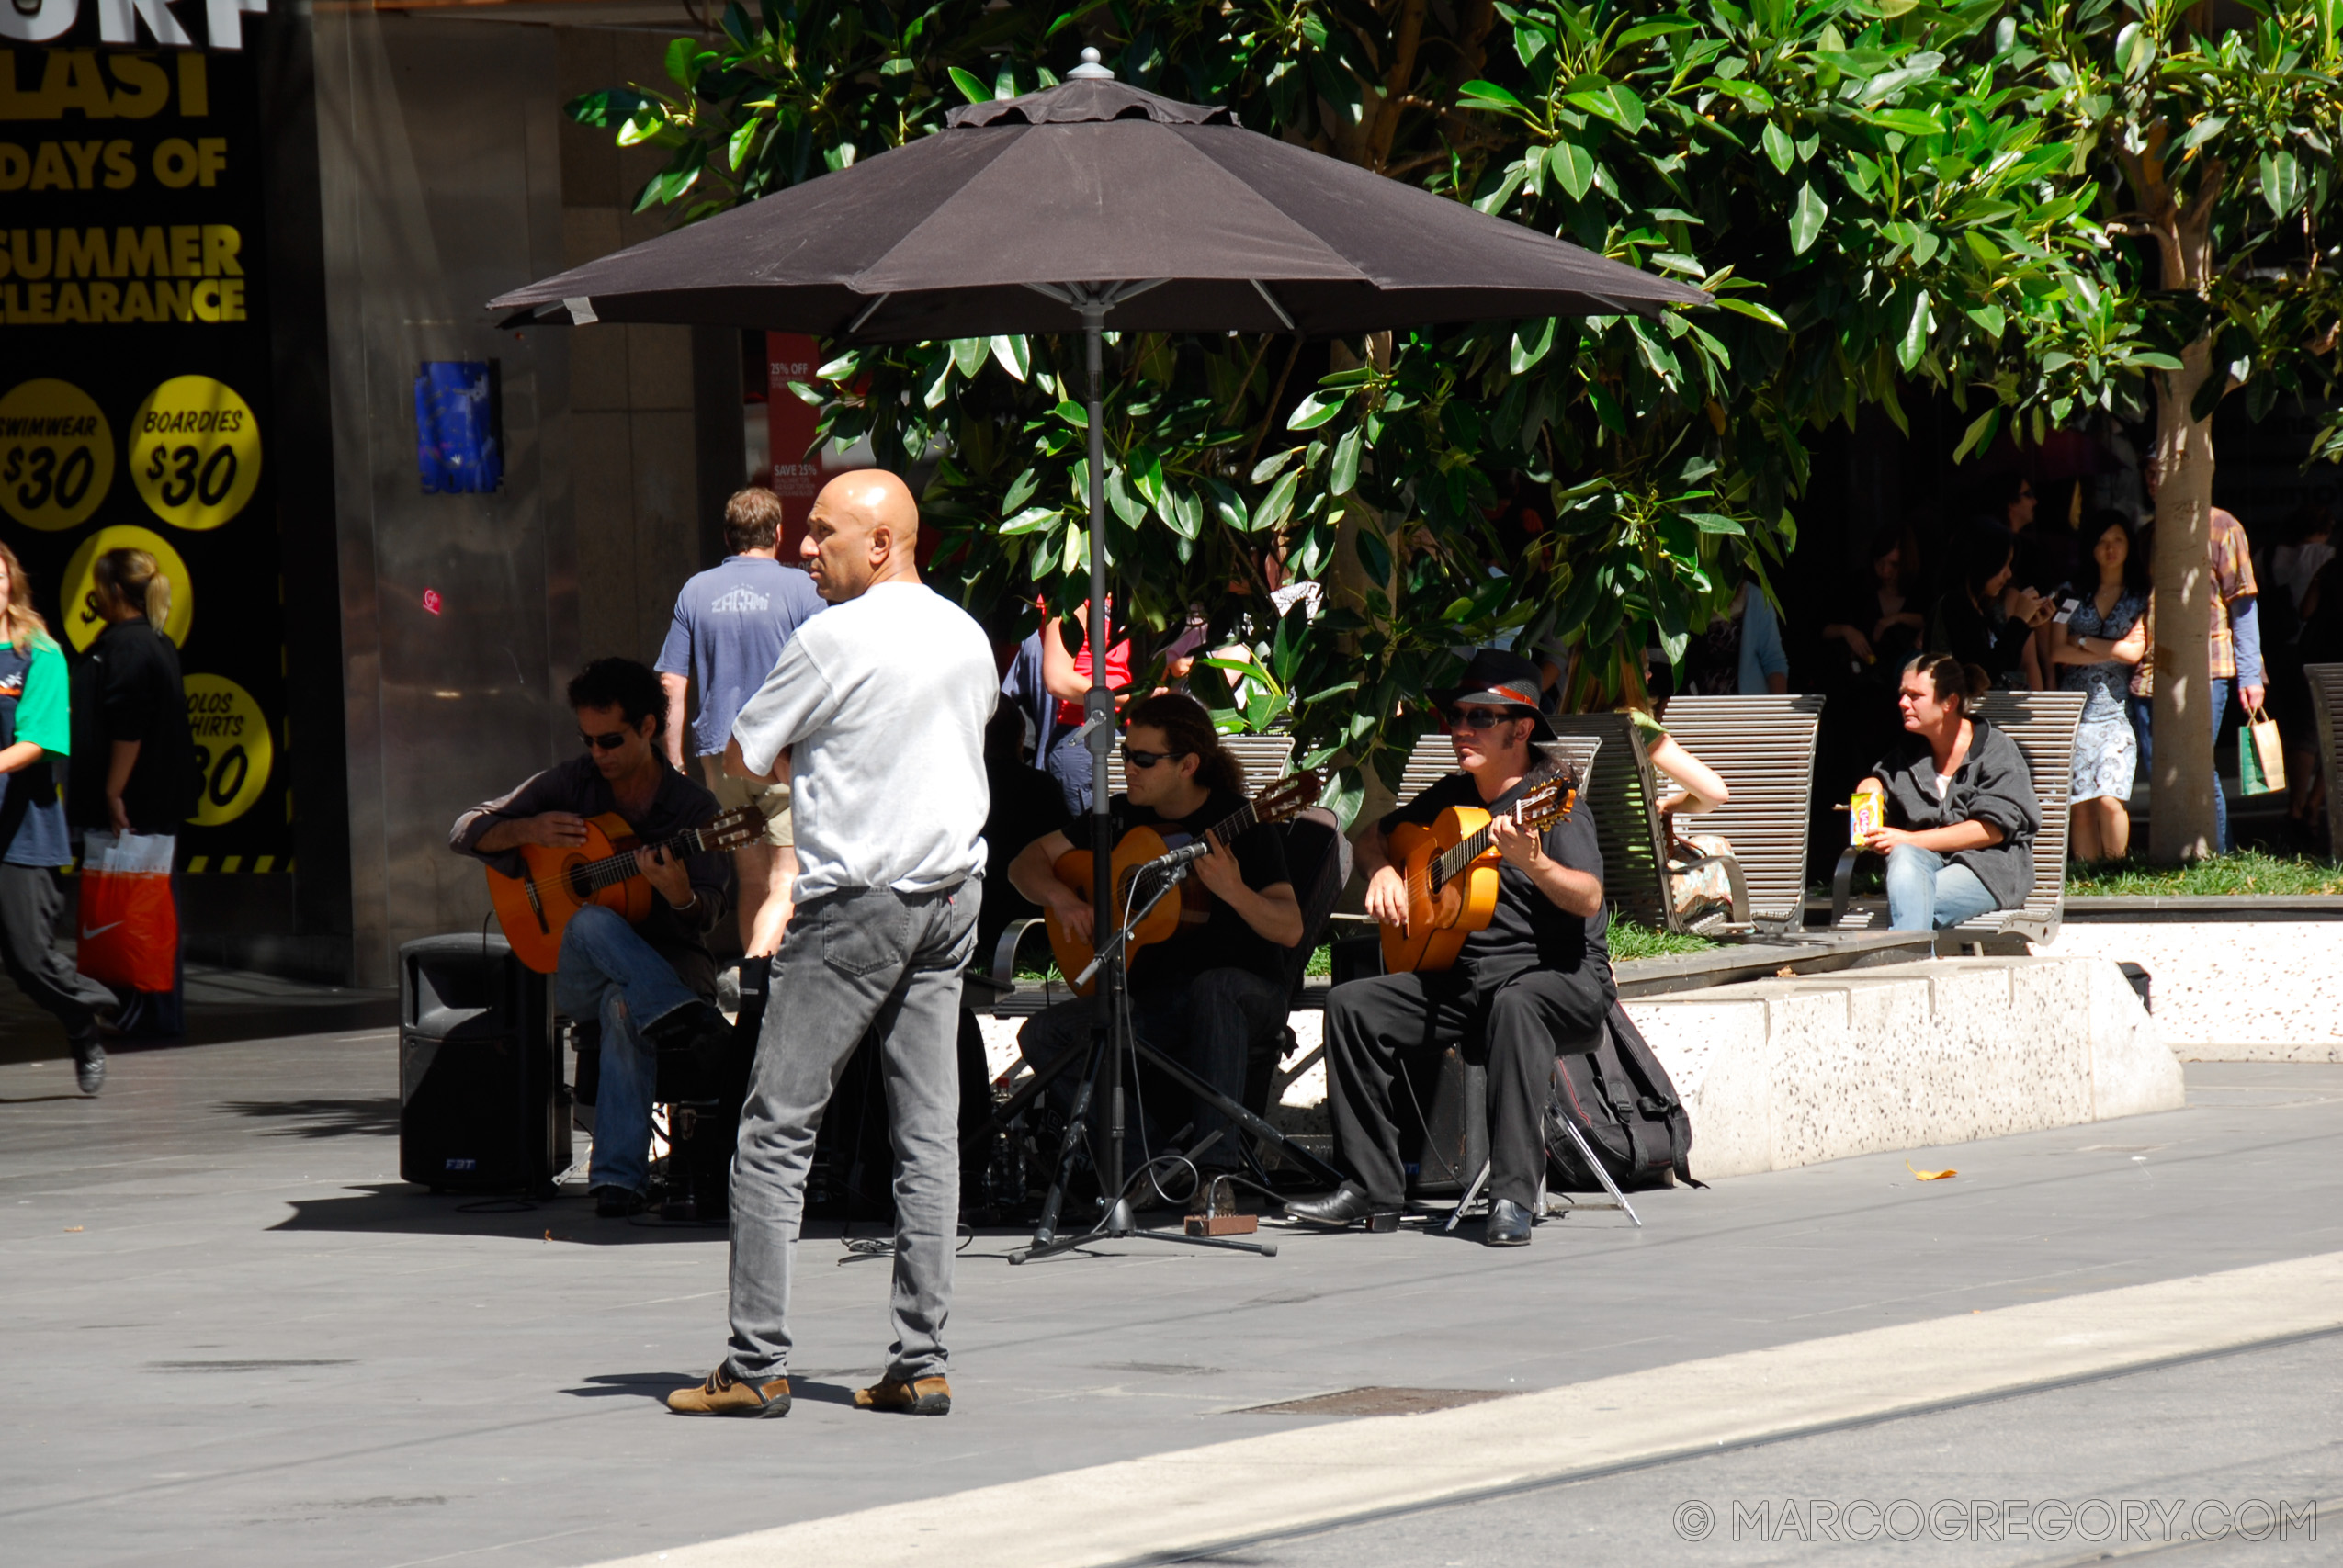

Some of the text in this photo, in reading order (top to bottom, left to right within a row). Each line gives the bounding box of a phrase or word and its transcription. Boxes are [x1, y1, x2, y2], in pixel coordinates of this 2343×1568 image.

[0, 138, 227, 190] DAYS OF
[0, 279, 246, 323] LEARANCE
[770, 363, 809, 375] 25% OFF
[142, 410, 243, 434] BOARDIES
[3, 445, 94, 509] $30
[146, 441, 237, 507] $30
[774, 464, 817, 476] SAVE 25%
[185, 692, 232, 714] OLOS
[445, 1158, 476, 1169] FBT
